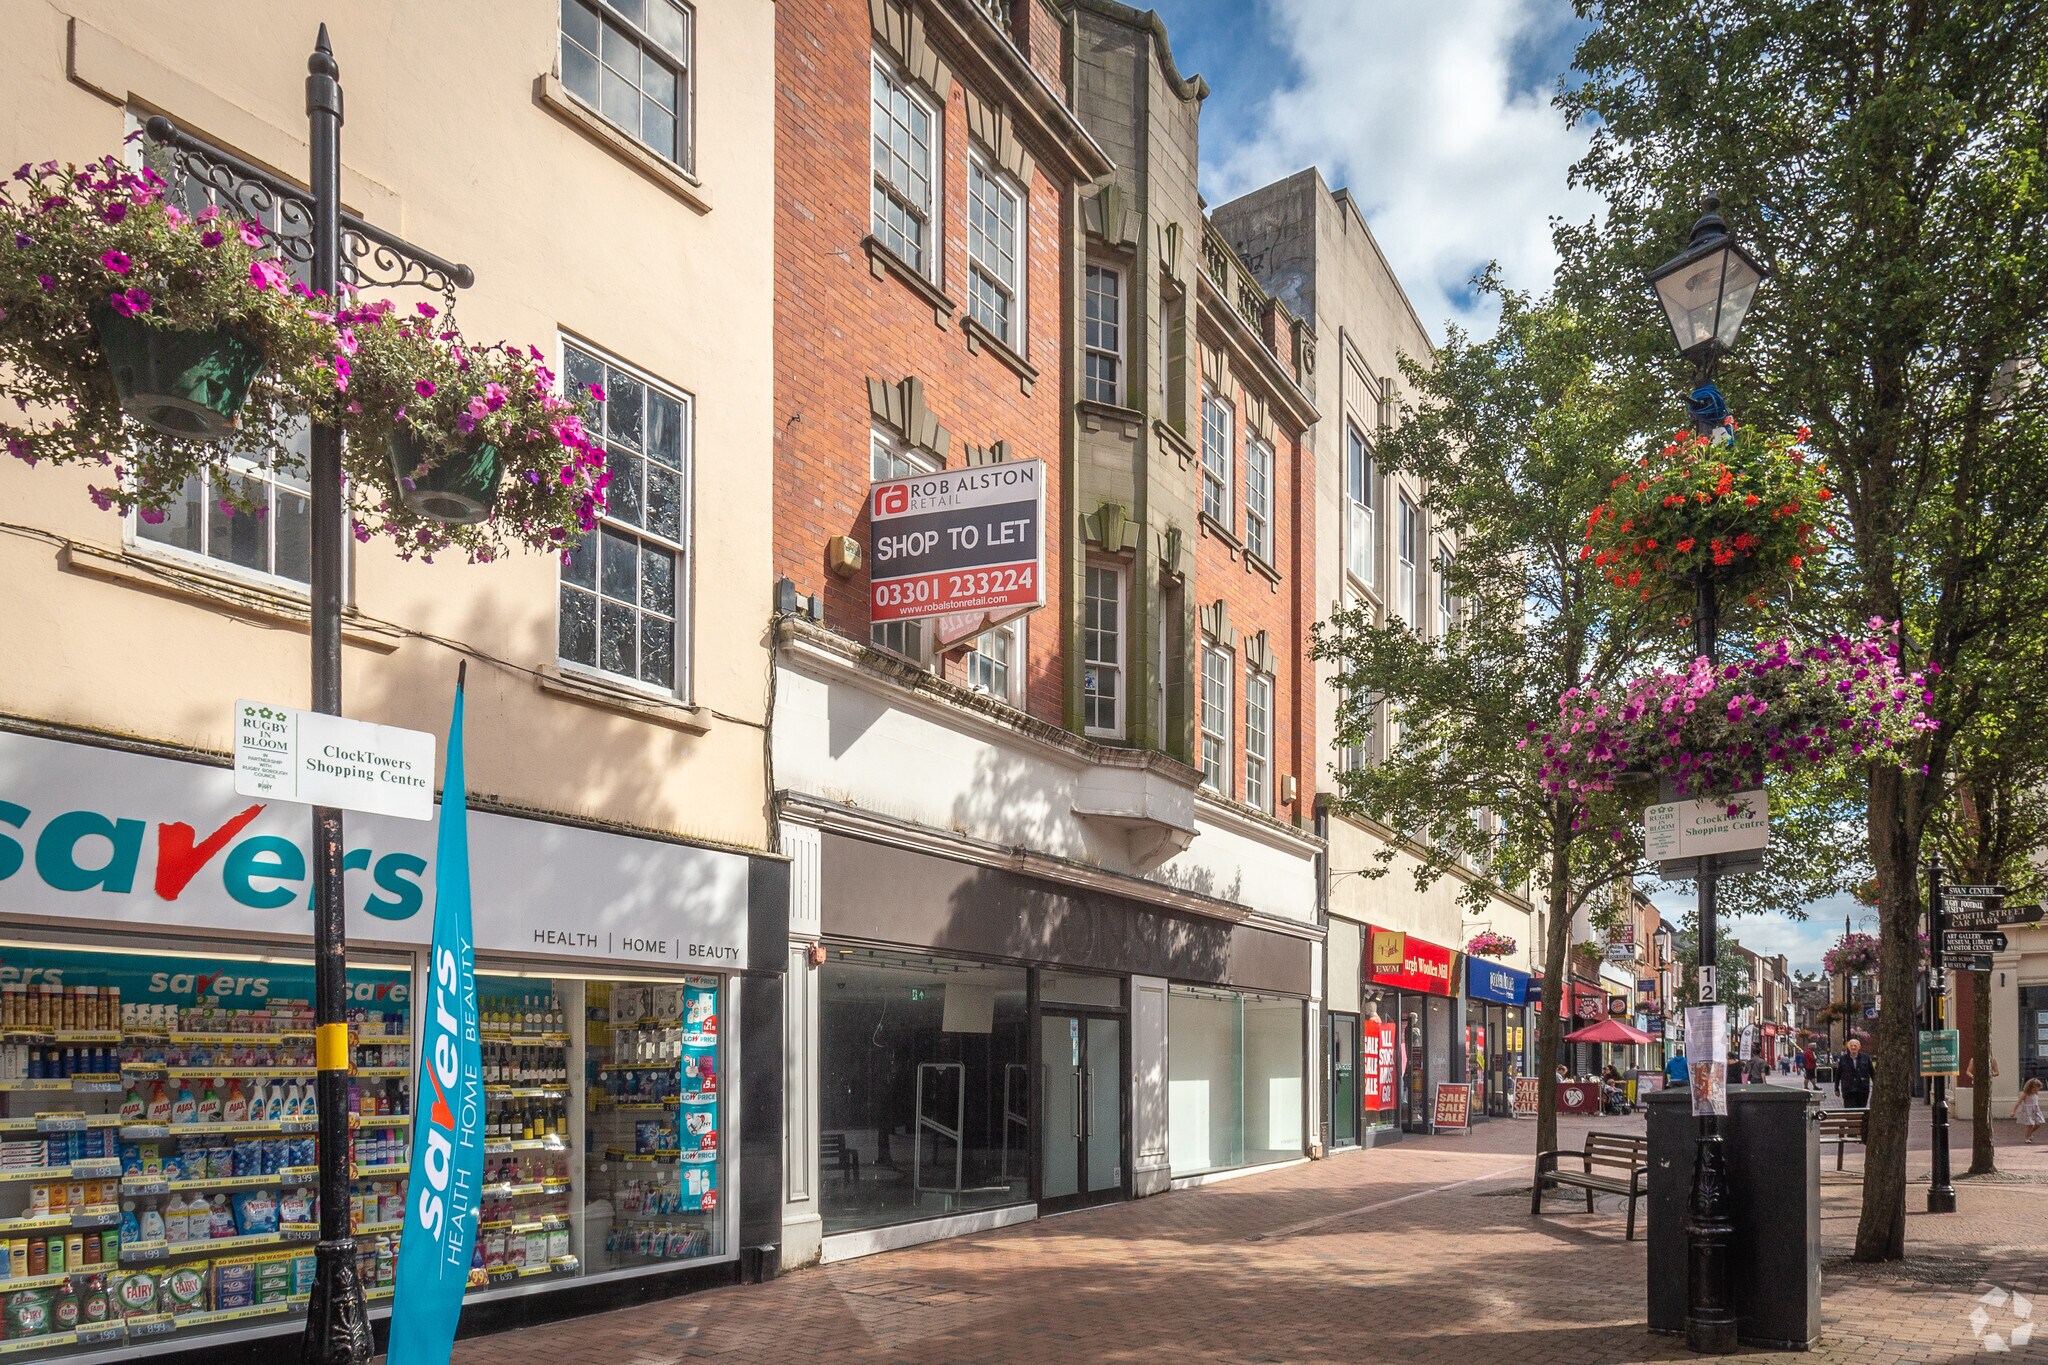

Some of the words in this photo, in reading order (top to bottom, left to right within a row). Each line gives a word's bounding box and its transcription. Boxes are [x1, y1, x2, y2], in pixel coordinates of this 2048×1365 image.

[911, 480, 949, 498] ROB
[957, 468, 1033, 492] ALSTON
[911, 494, 961, 511] RETAIL
[877, 530, 939, 561] SHOP
[947, 525, 979, 550] TO
[987, 519, 1030, 546] LET
[875, 578, 939, 607] 03301
[950, 567, 1032, 598] 233224
[899, 594, 1008, 615] www.robalstonretail.com
[243, 718, 288, 733] RUGBY
[260, 731, 271, 739] IN
[243, 736, 288, 751] BLOOM
[323, 744, 412, 770] ClockTowers
[306, 758, 374, 781] Shopping
[380, 770, 426, 787] Centre
[1649, 813, 1675, 822] RUGBY
[1649, 824, 1675, 832] BLOOM
[1685, 824, 1729, 836] Shopping
[1732, 820, 1765, 830] Centre
[1952, 912, 1983, 920] NORTH
[1988, 908, 2026, 917] STREET
[1975, 917, 2000, 925] PARK
[534, 930, 598, 948] HEALTH
[622, 937, 666, 954] HOME
[688, 944, 740, 960] BEAUTY
[1376, 965, 1400, 973] EWM
[1418, 957, 1438, 977] Woollen
[1437, 963, 1448, 979] Mill
[700, 977, 717, 985] PRICE
[1702, 968, 1711, 983] 1
[148, 969, 270, 997] savers
[461, 937, 478, 1042] BEAUTY
[1702, 985, 1713, 1000] 2
[1381, 1030, 1393, 1047] ALL
[420, 943, 459, 1242] savers
[1365, 1078, 1379, 1096] ALE
[1516, 1081, 1538, 1092] SALE
[1439, 1093, 1467, 1102] SALE
[1515, 1092, 1538, 1103] SALE
[123, 1102, 141, 1115] AJAX
[154, 1102, 171, 1114] AJAX
[176, 1101, 194, 1114] AJAX
[200, 1101, 217, 1113] AJAX
[229, 1100, 245, 1112] AJAX
[459, 1065, 478, 1148] HOME
[1437, 1103, 1466, 1112] SALE
[1513, 1102, 1538, 1113] SALE
[1436, 1112, 1465, 1122] SALE
[248, 1200, 268, 1210] Persil
[283, 1200, 303, 1209] Persil
[447, 1169, 472, 1266] HEALTH
[126, 1285, 152, 1299] FAIRY
[174, 1278, 198, 1294] FAIRY
[61, 1308, 77, 1316] FAIRY
[90, 1303, 105, 1312] FAIRY
